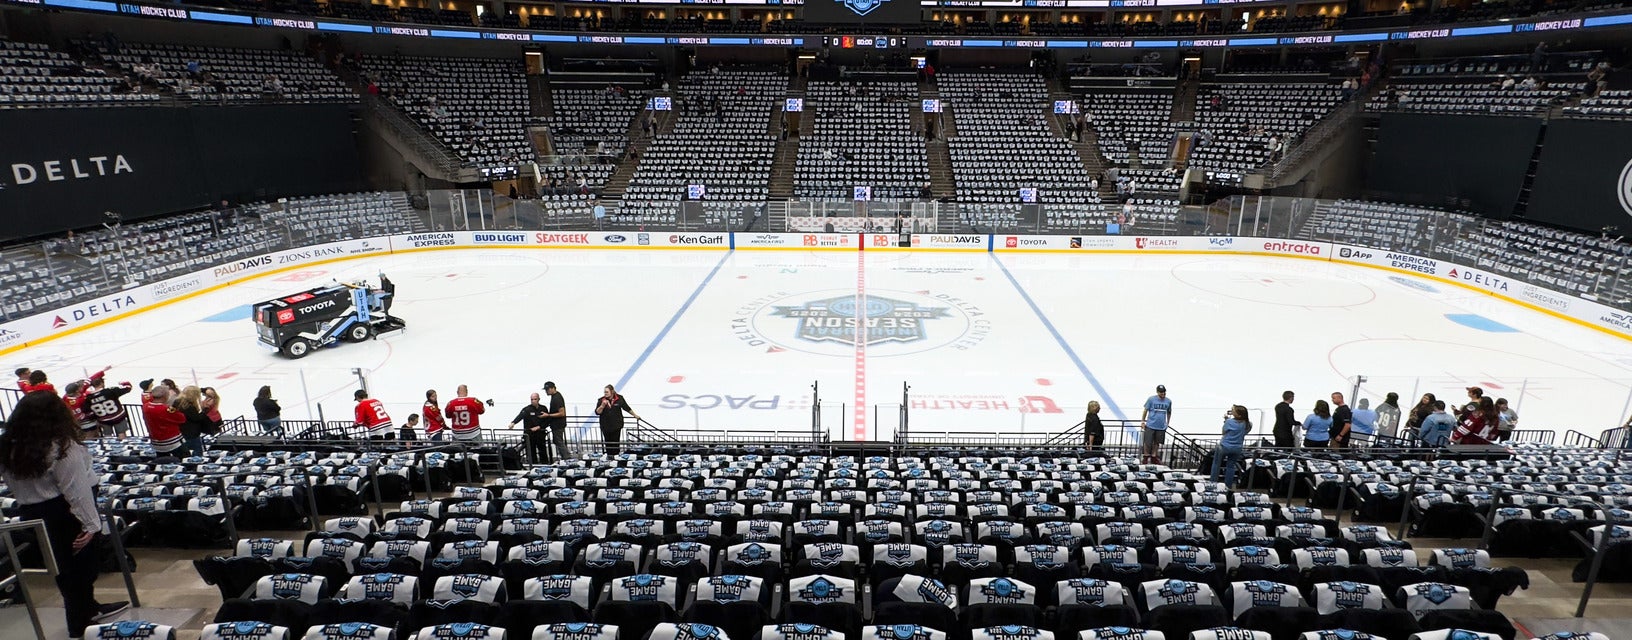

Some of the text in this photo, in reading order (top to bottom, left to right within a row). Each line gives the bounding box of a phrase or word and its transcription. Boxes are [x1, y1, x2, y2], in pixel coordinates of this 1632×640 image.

[140, 6, 168, 17] HOCKEY
[168, 9, 187, 18] CLUB
[273, 19, 298, 28] HOCKEY
[298, 21, 315, 29] CLUB
[1534, 21, 1560, 30] HOCKEY
[1562, 19, 1580, 28] CLUB
[392, 28, 414, 36] HOCKEY
[414, 29, 429, 37] CLUB
[1408, 30, 1432, 39] HOCKEY
[1432, 29, 1450, 37] CLUB
[833, 38, 839, 46] 0
[891, 38, 897, 46] 0
[1294, 36, 1316, 44] HOCKEY
[11, 154, 134, 185] DELTA
[407, 233, 454, 242] AMERICAN
[415, 239, 456, 247] EXPRESS
[474, 234, 497, 242] BUD
[536, 233, 589, 244] SEATGEEK
[678, 235, 723, 244] Ken Garff
[1264, 242, 1320, 255] entrata
[279, 251, 311, 264] ZIONS
[314, 246, 344, 257] BANK
[1385, 252, 1437, 268] AMERICAN
[1392, 260, 1436, 275] EXPRESS
[1464, 270, 1508, 292] DELTA
[154, 279, 200, 298] INGREDIENTS
[73, 295, 136, 321] DELTA
[298, 300, 336, 315] TOYOTA
[357, 291, 367, 319] UTAH
[804, 317, 917, 328] SEASON
[1600, 316, 1631, 330] AMERICA
[658, 394, 781, 410] PACS
[912, 400, 1010, 410] HEALTH
[91, 400, 118, 416] 88
[453, 410, 471, 426] 19
[274, 580, 301, 590] GAME
[366, 582, 394, 592] GAME
[454, 575, 482, 588] GAME
[544, 580, 570, 590] GAME
[630, 586, 656, 596] GAME
[715, 584, 740, 596] GAME
[922, 578, 950, 602] GAME
[1076, 586, 1104, 596] GAME
[988, 596, 1016, 604] GAME
[1168, 592, 1194, 604] GAME
[1254, 592, 1280, 600] GAME
[1336, 592, 1362, 600] GAME
[1218, 629, 1250, 640] GAME
